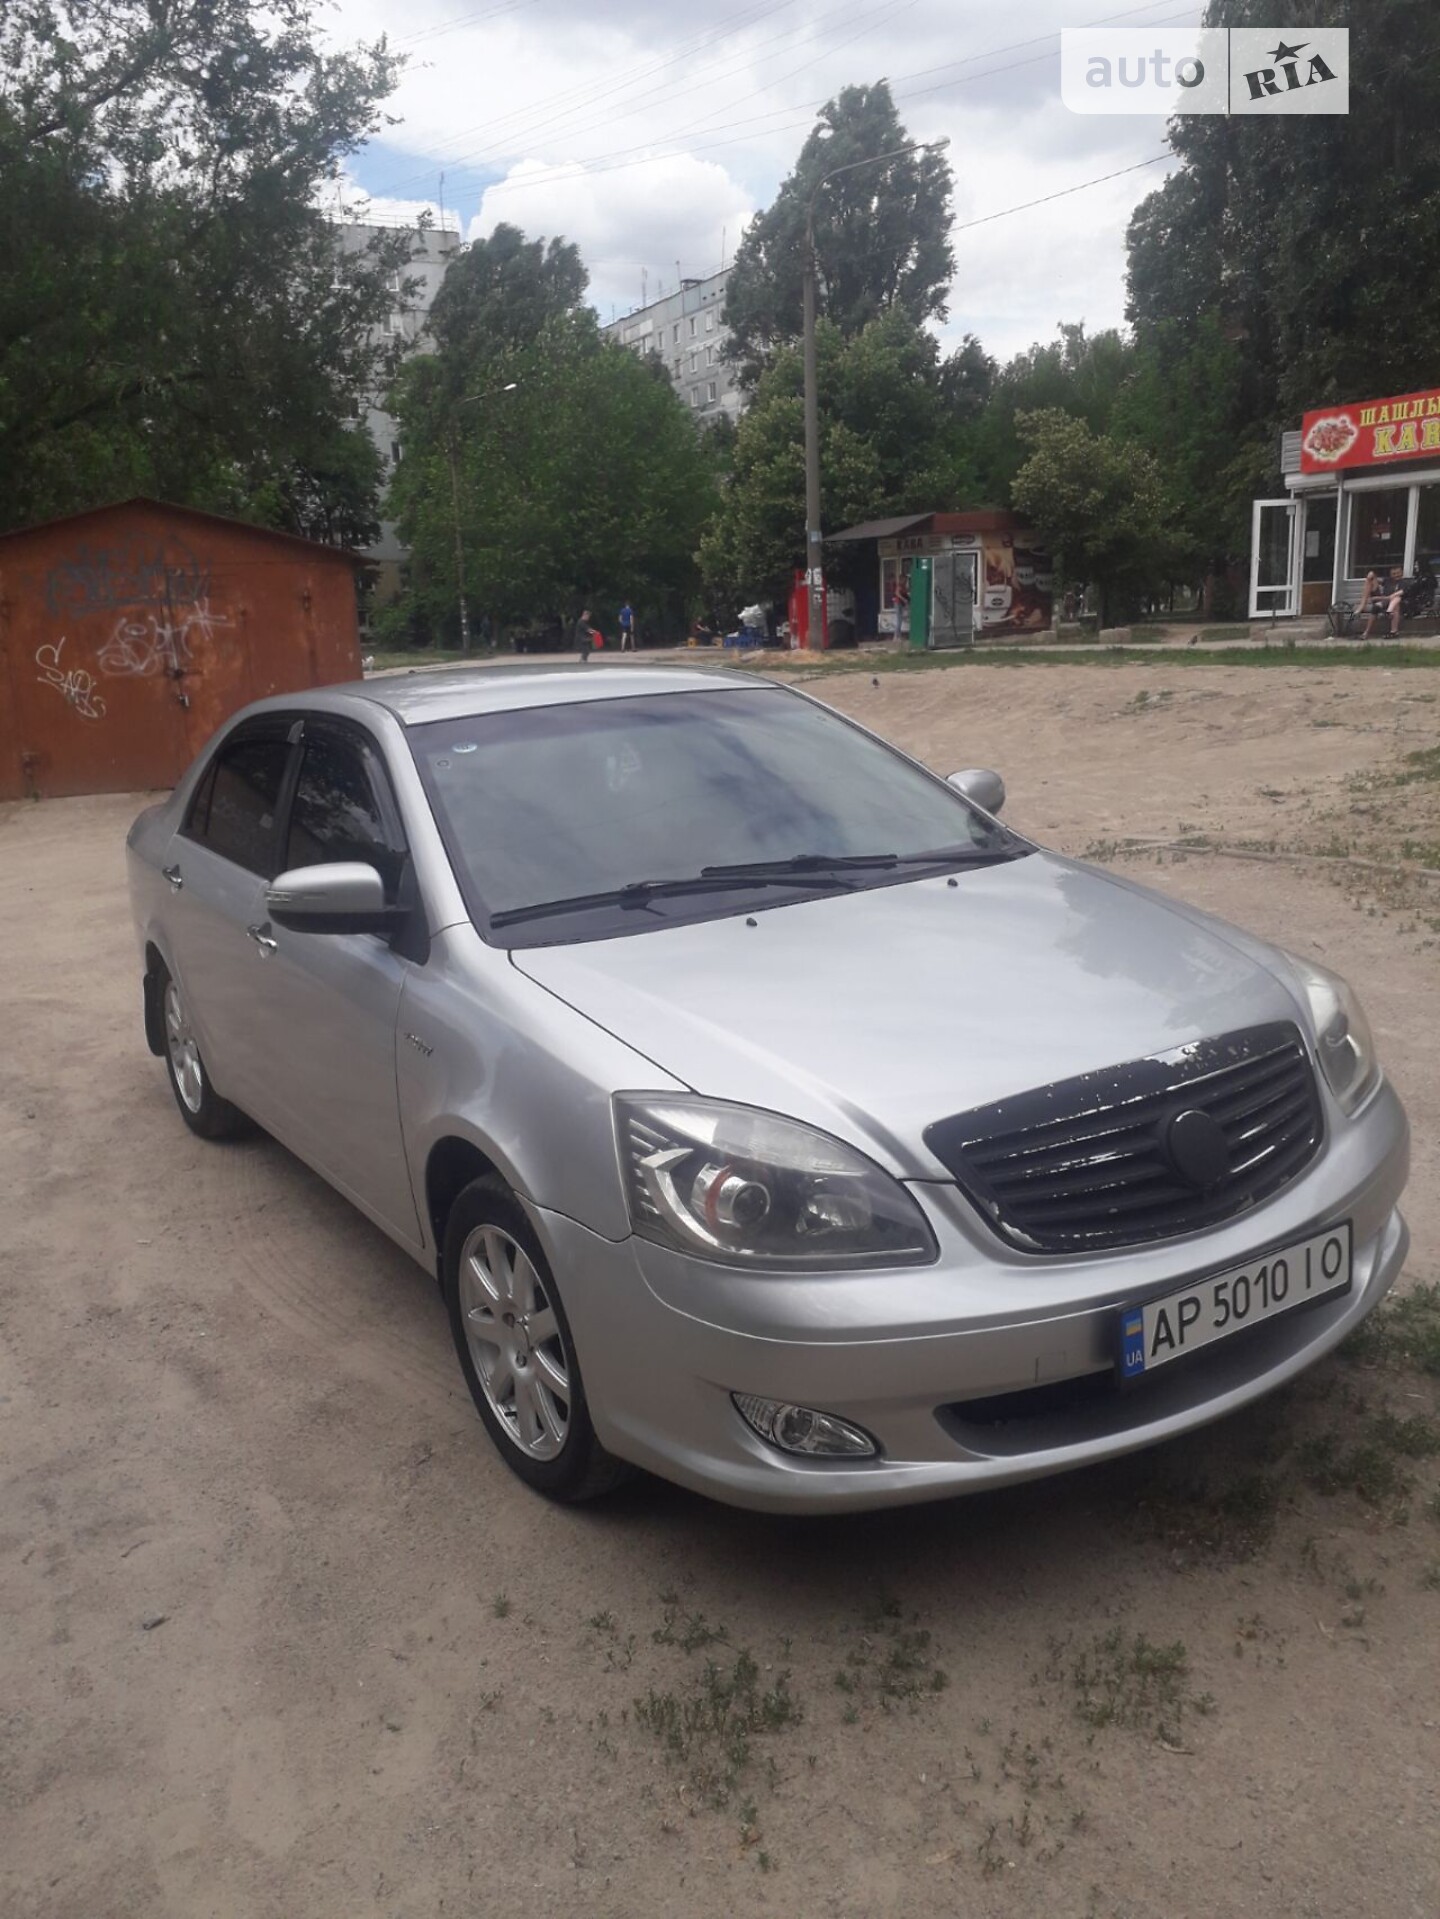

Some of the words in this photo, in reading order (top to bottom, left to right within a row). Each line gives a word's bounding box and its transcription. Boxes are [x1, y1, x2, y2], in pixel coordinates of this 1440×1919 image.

[1151, 1296, 1202, 1357] AP
[1213, 1258, 1289, 1328] 5010
[1125, 1350, 1144, 1367] UA
